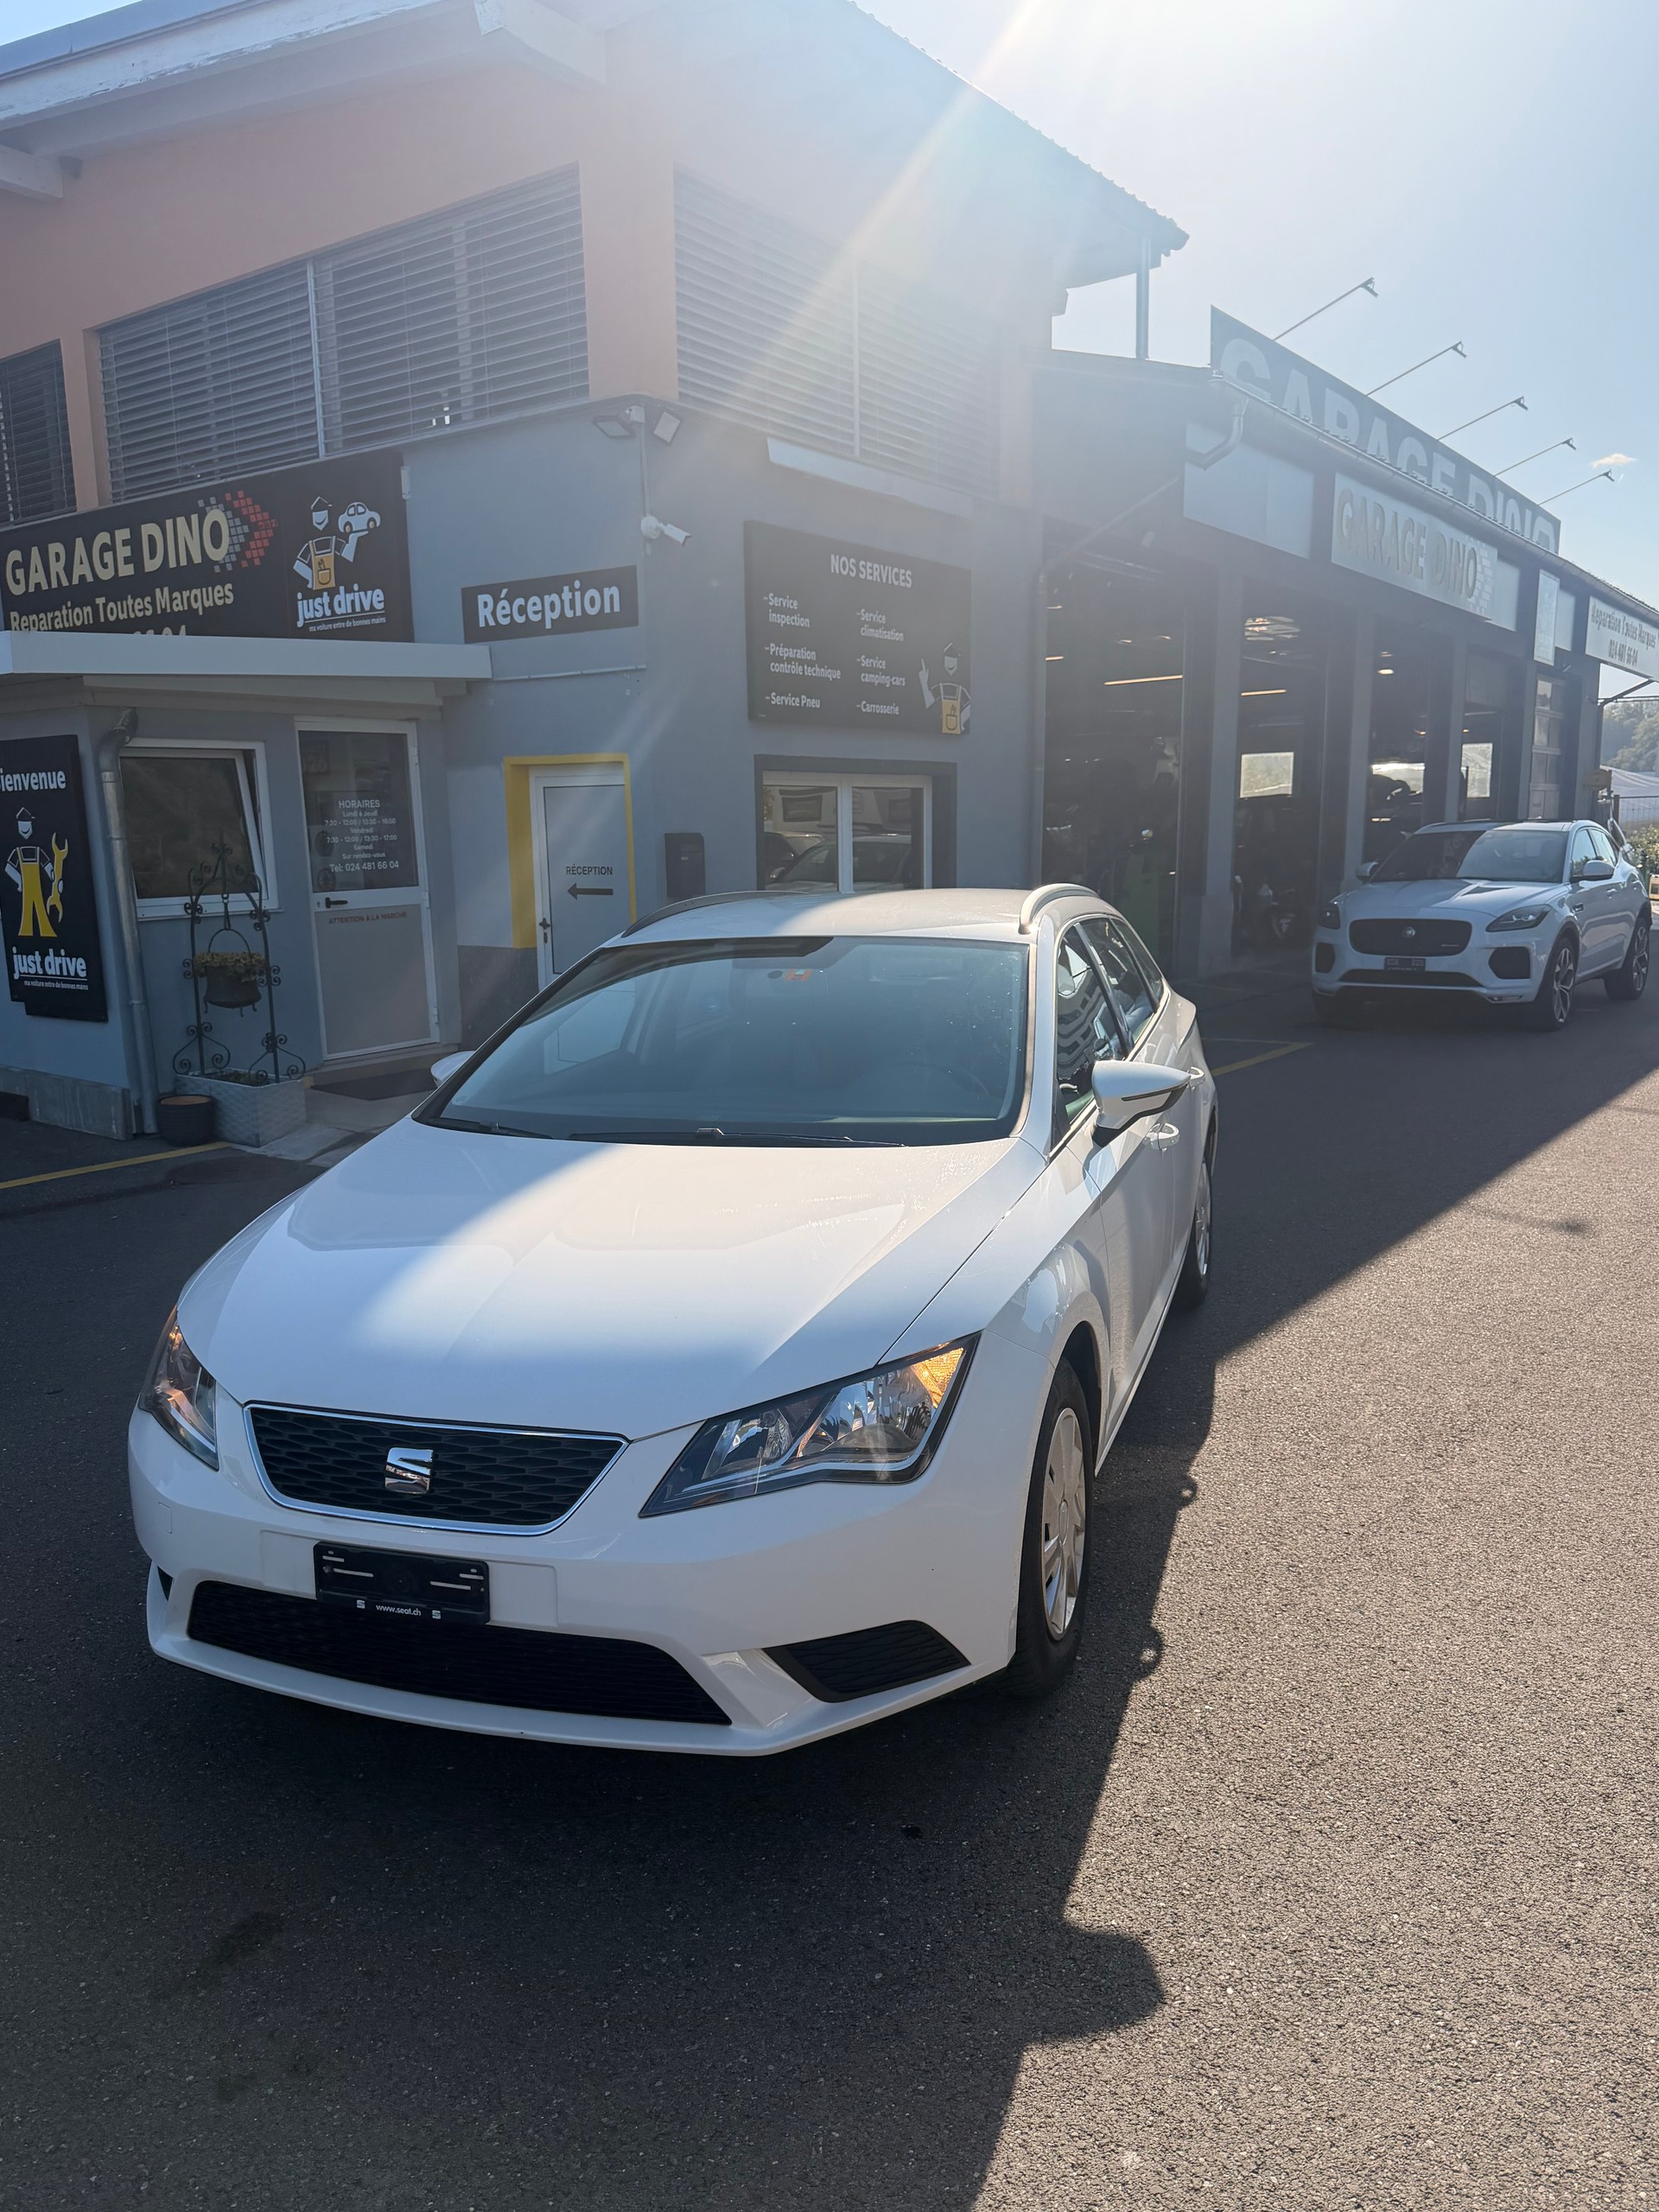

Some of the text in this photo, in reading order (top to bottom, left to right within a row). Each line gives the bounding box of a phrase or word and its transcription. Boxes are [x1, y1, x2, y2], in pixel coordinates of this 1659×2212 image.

[5, 508, 230, 596] GARAGE DINO
[1337, 487, 1478, 599] GARAGE DINO
[830, 554, 912, 588] NOS SERVICES
[10, 582, 234, 632] Reparation Toutes Marques
[296, 582, 385, 628] just drive
[477, 579, 620, 630] Réception
[768, 609, 810, 628] inspection
[861, 624, 904, 642] climatisation
[770, 662, 842, 681] contrôle technique
[861, 671, 906, 687] camping-cars
[801, 695, 821, 708] Pneu
[0, 767, 67, 791] ienvenue
[338, 799, 381, 809] HORAIRES
[362, 861, 376, 870] 481
[389, 861, 399, 869] 04
[566, 864, 613, 875] RÉCEPTION
[328, 915, 364, 925] ATTENTION
[12, 946, 87, 980] just drive
[375, 1605, 422, 1617] www.seat.ch
